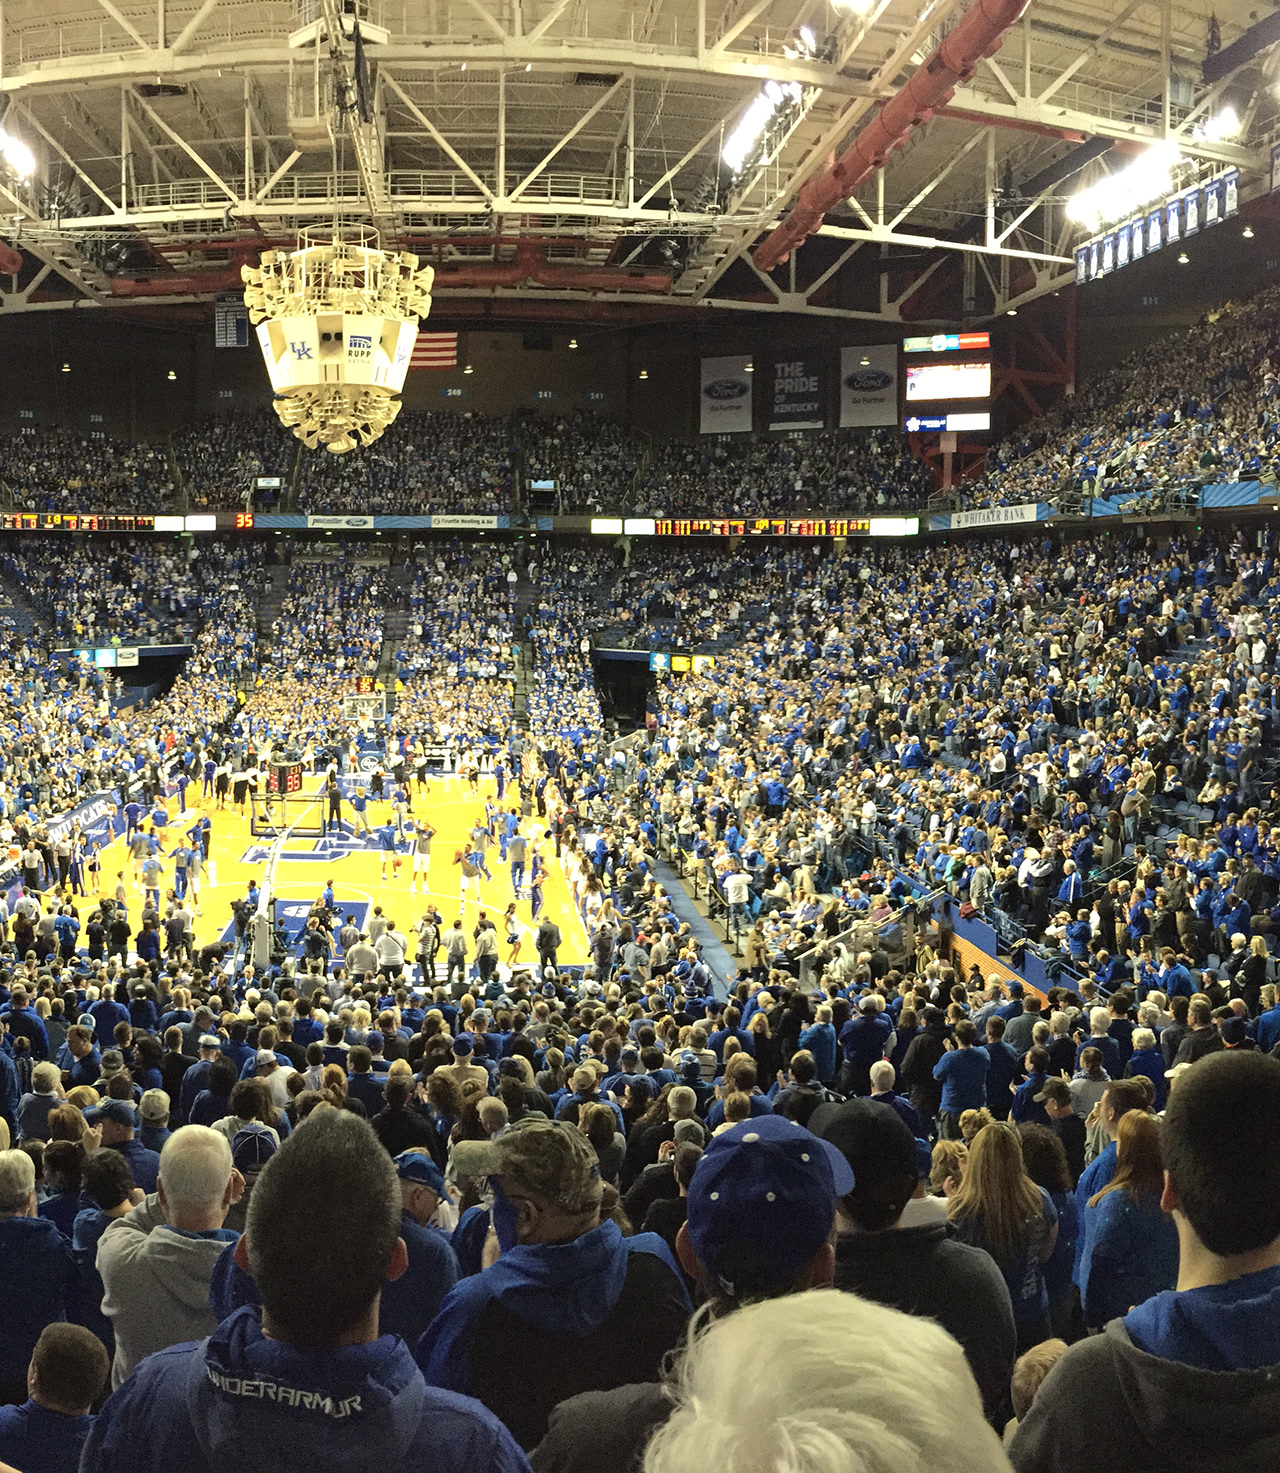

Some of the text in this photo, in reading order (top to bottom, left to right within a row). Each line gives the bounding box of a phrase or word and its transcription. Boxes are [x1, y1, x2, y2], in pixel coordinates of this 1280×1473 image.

[290, 341, 314, 360] UK
[348, 350, 371, 358] RUPP
[774, 361, 804, 377] THE
[774, 376, 819, 393] PRIDE
[853, 373, 885, 389] Ford
[711, 384, 742, 398] Ford
[773, 402, 820, 413] KENTUCKY
[774, 395, 786, 404] OF
[236, 513, 254, 528] 35
[964, 507, 1025, 524] WHITAKER BANK
[360, 682, 371, 692] 35
[286, 774, 301, 792] 35
[49, 799, 107, 842] WILDCATS
